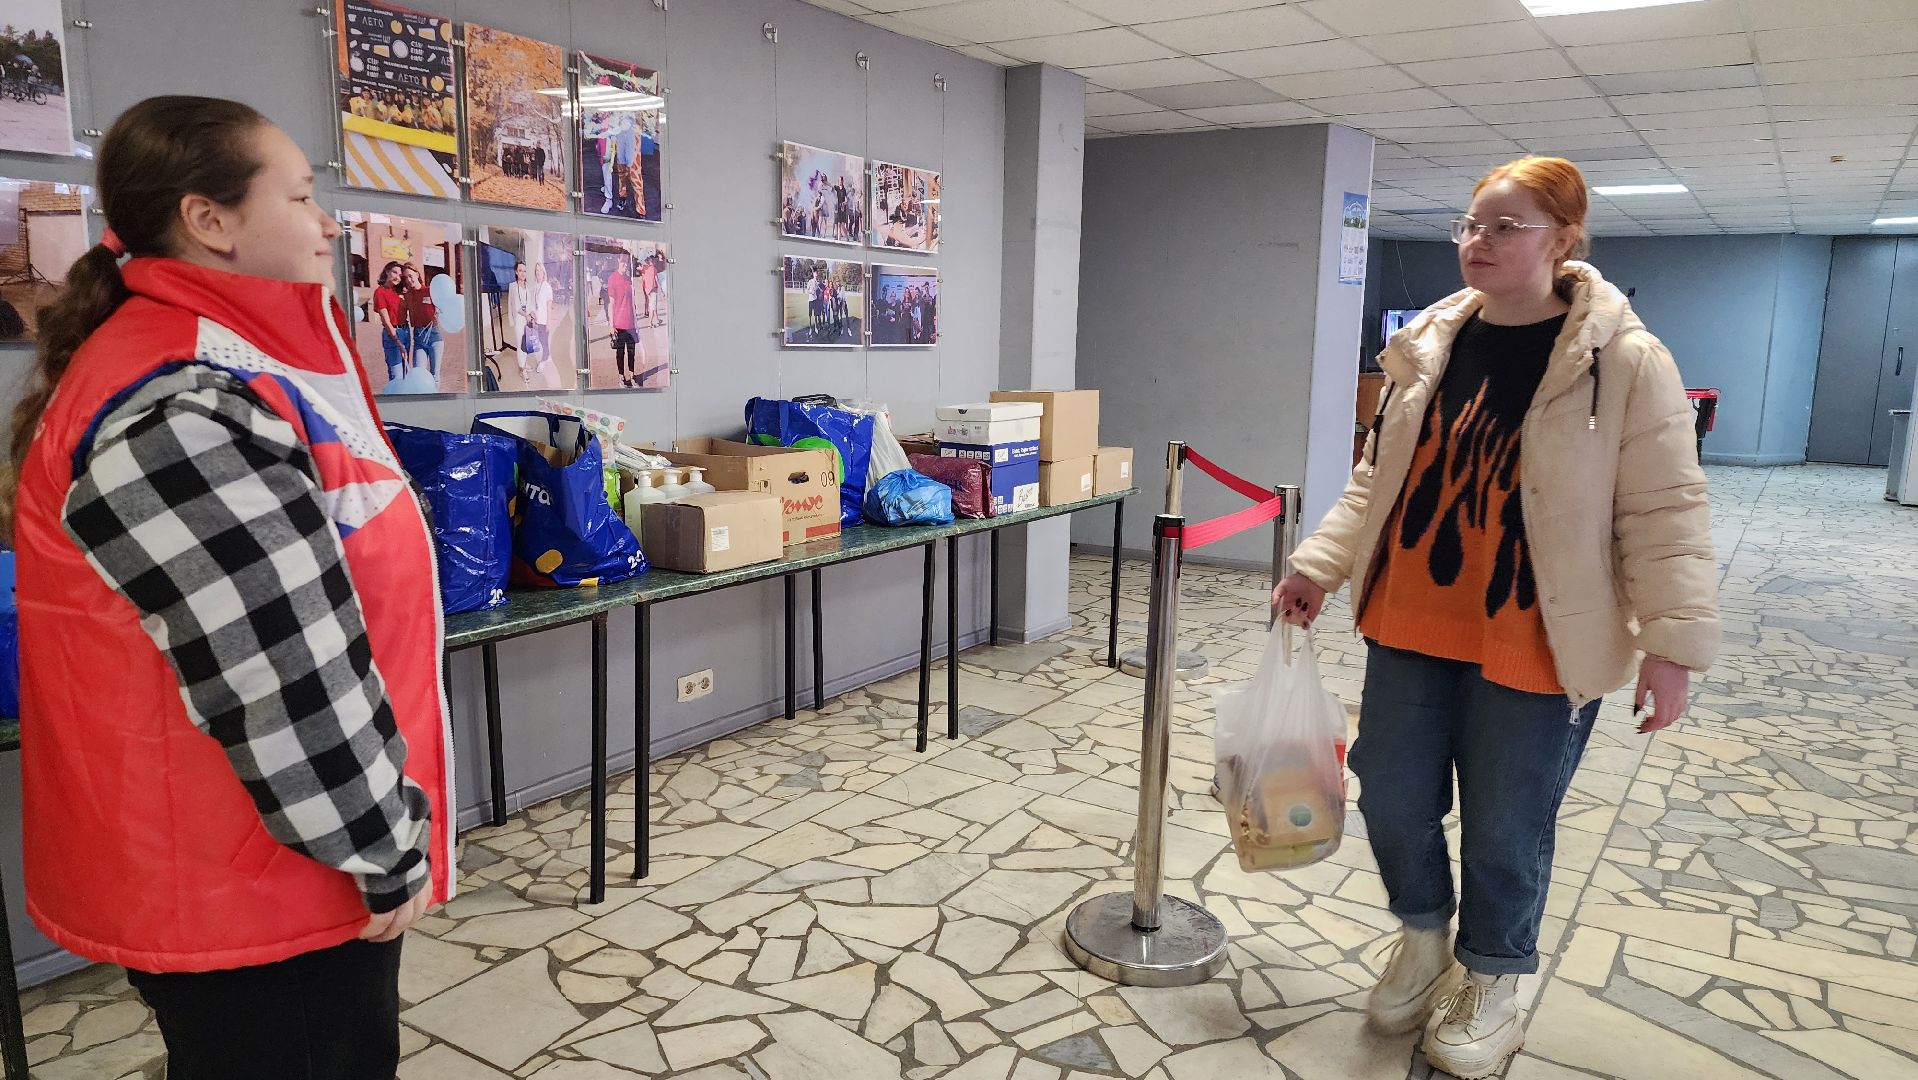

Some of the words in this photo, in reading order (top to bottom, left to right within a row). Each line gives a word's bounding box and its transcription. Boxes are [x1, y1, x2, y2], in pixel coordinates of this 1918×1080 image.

[362, 16, 384, 28] ЛЕТО
[398, 73, 420, 85] ЛЕТО
[821, 471, 835, 487] 09
[780, 494, 824, 516] омус
